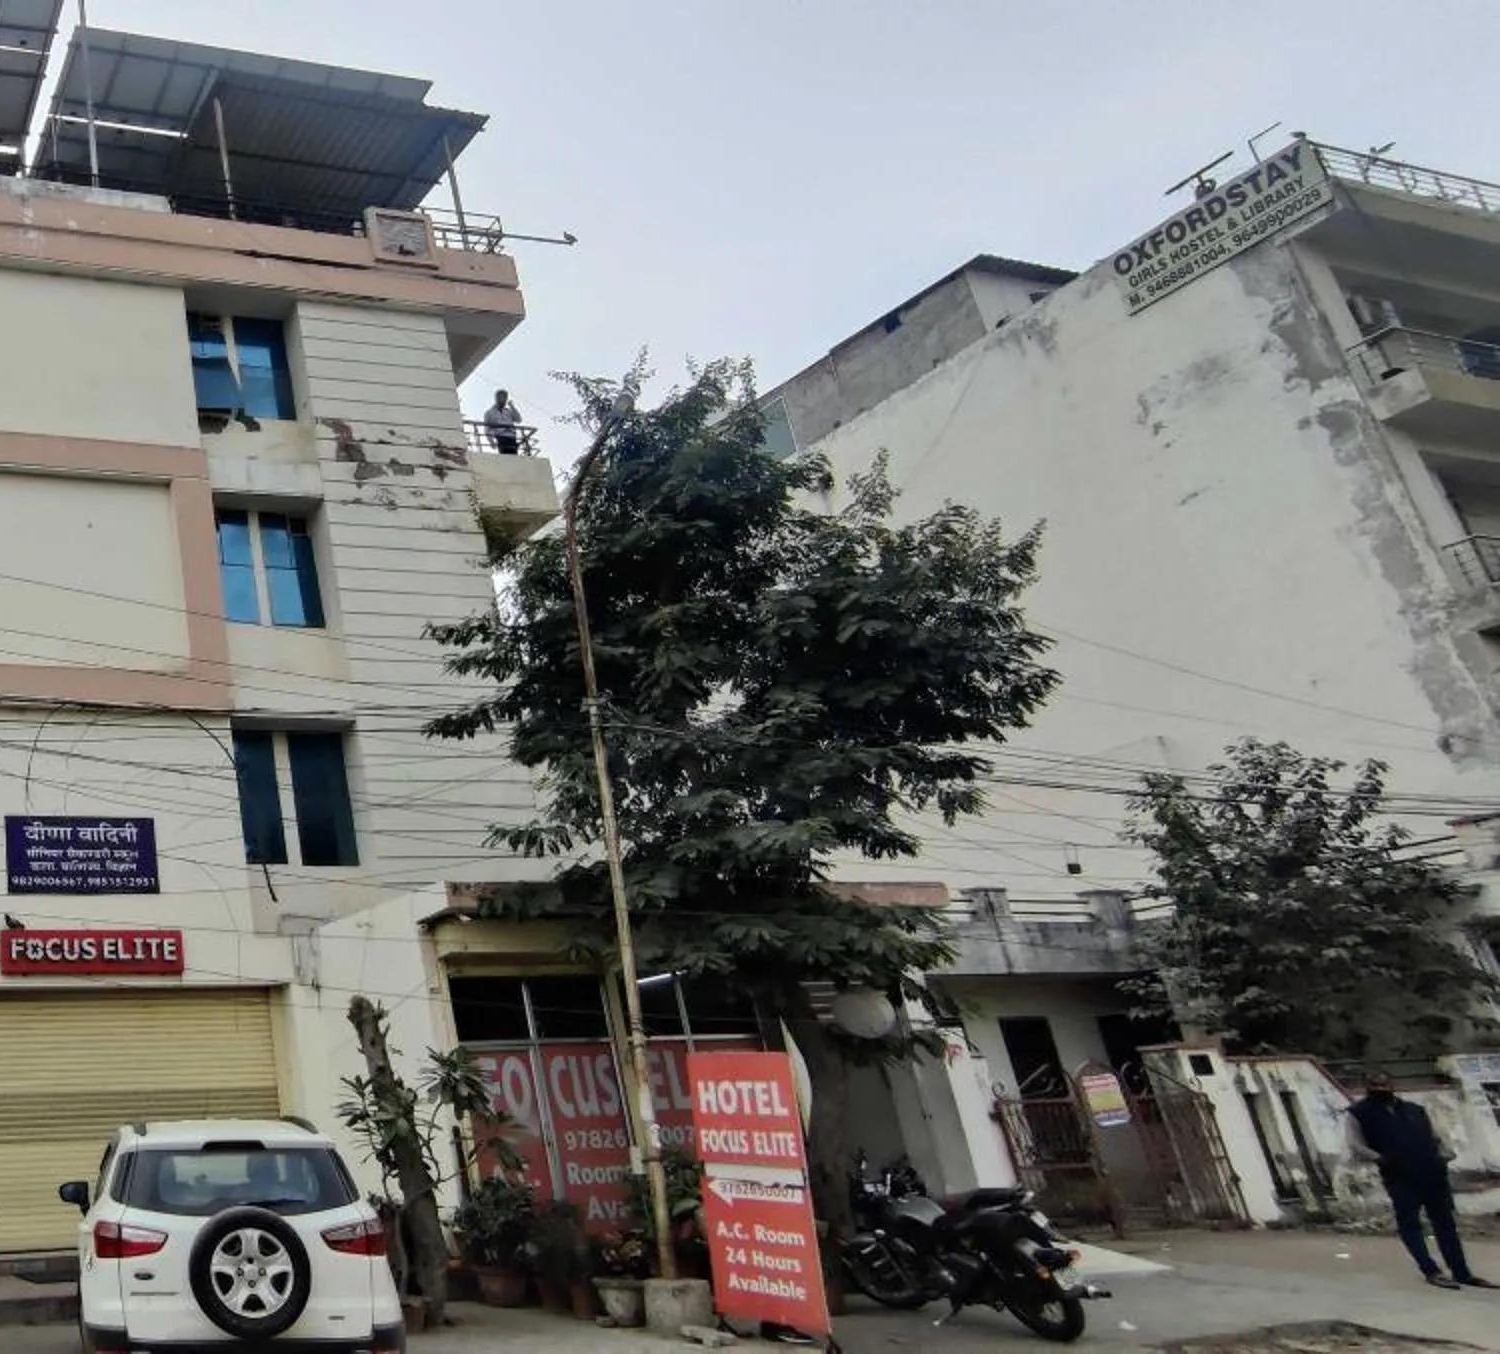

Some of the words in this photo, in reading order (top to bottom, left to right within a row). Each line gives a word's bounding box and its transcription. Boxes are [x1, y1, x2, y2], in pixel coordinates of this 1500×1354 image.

[1128, 255, 1169, 288] GIRLS
[1169, 227, 1225, 264] HOSTEL
[1227, 217, 1239, 231] &
[1240, 175, 1305, 222] LIBRARY
[76, 822, 139, 844] वादिनी
[10, 937, 98, 961] FOCUS
[102, 937, 178, 961] ELITE
[697, 1080, 790, 1117] HOTEL
[700, 1129, 750, 1155] FOCUS
[752, 1131, 798, 1157] ELITE
[716, 1220, 750, 1240] A.C.
[753, 1223, 805, 1248] Room
[725, 1245, 747, 1264] 24
[751, 1250, 802, 1273] Hours
[728, 1272, 806, 1301] Available
